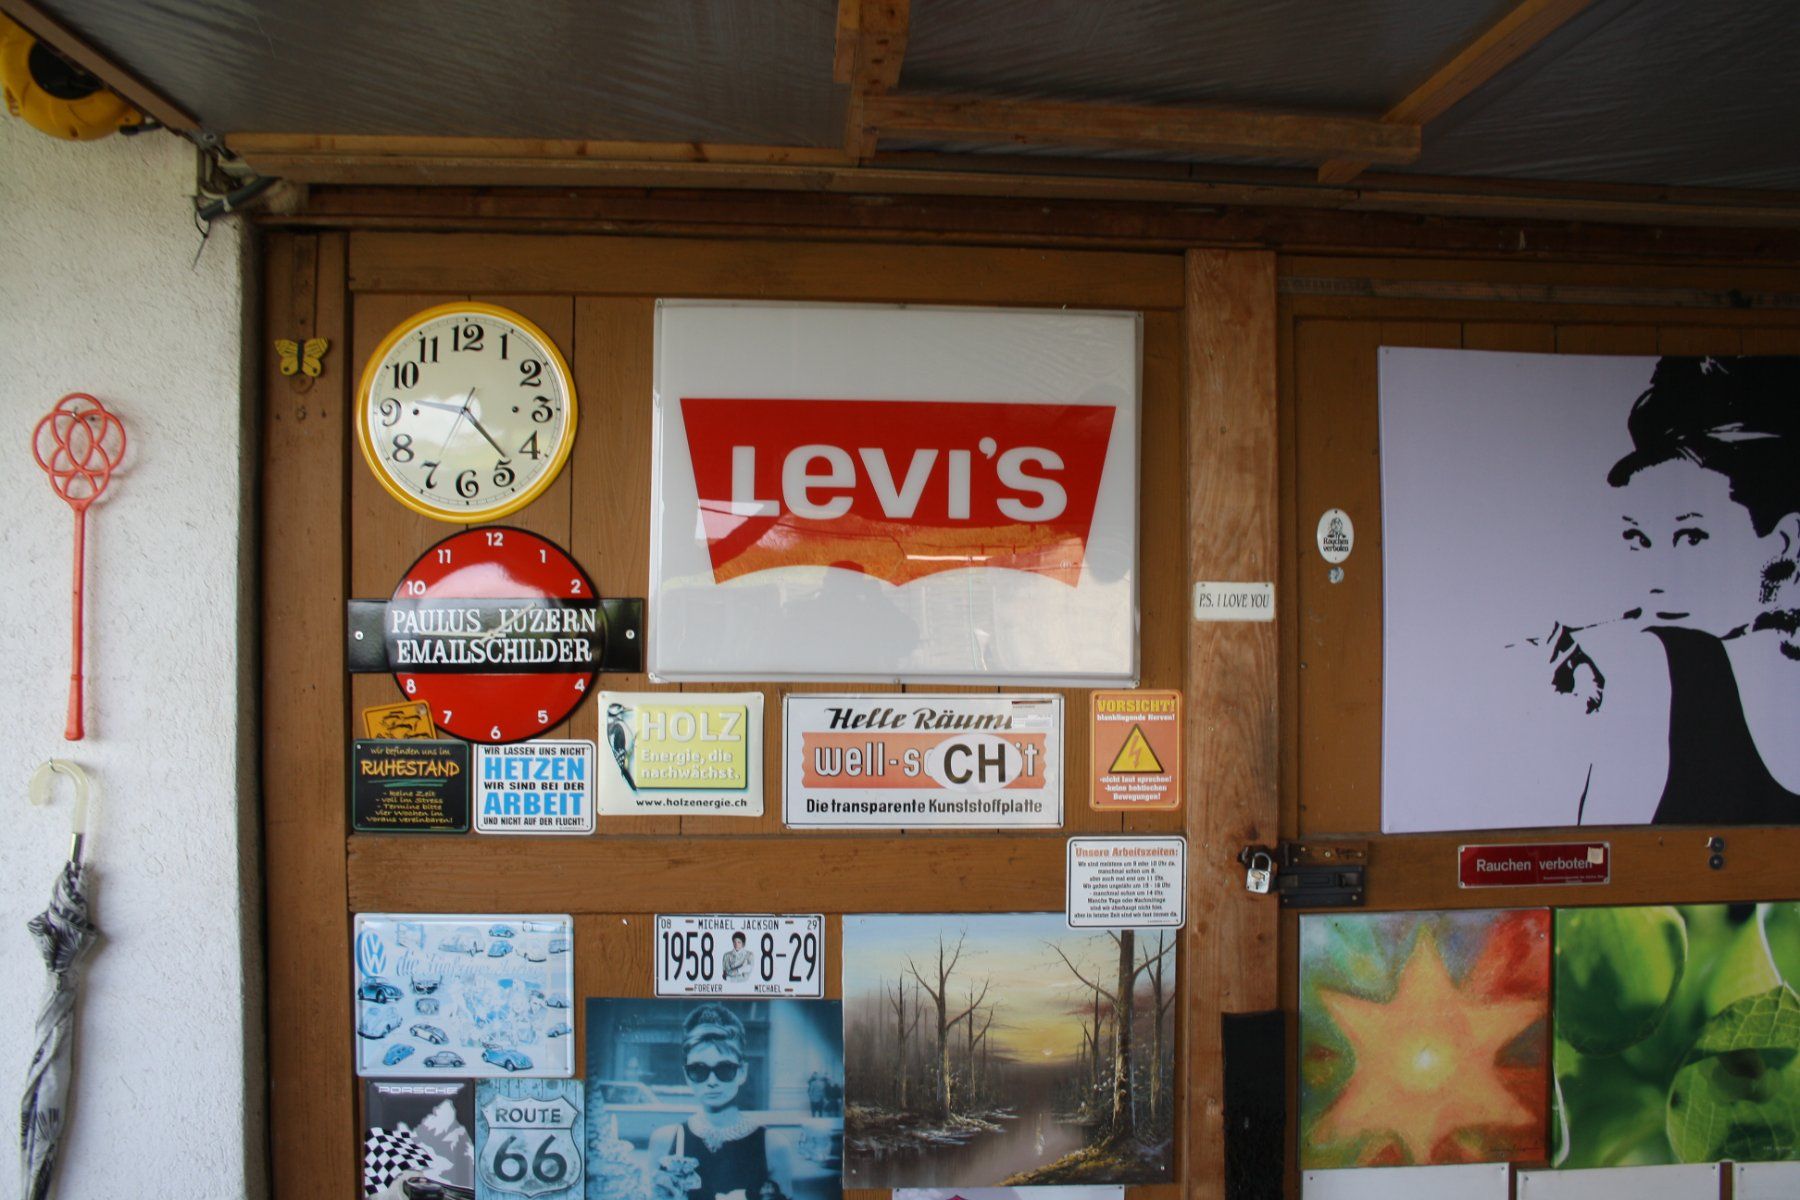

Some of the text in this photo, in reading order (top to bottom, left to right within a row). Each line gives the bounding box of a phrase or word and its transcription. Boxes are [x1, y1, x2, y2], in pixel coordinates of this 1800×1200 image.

[451, 324, 484, 352] 12
[419, 335, 440, 363] 11
[500, 333, 509, 360] 1
[391, 361, 419, 389] 10
[520, 359, 542, 387] 2
[380, 398, 401, 427] 9
[531, 396, 553, 423] 3
[392, 434, 415, 463] 8
[519, 430, 541, 460] 4
[420, 460, 441, 489] 7
[493, 459, 515, 487] 5
[455, 470, 479, 498] 6
[486, 532, 504, 547] 12
[437, 549, 451, 564] 11
[540, 549, 547, 563] 1
[407, 580, 426, 595] 10
[571, 579, 581, 594] 2
[1199, 593, 1270, 608] P.S. I LOVE YOU
[391, 608, 597, 634] PAULUS LUZERN
[397, 638, 592, 664] EMAILSCHILDER
[406, 679, 416, 693] 8
[574, 679, 585, 692] 4
[1097, 700, 1175, 712] VORSICHT!
[443, 711, 452, 724] 7
[538, 711, 548, 724] 5
[824, 708, 906, 730] Helle
[490, 726, 501, 740] 6
[641, 711, 742, 742] HOLZ
[386, 747, 420, 756] befinden
[422, 747, 437, 756] uns
[484, 747, 585, 755] WIR LASSEN UNS NICHT
[642, 749, 733, 765] Energie, die
[361, 759, 460, 777] RUHESTAND
[484, 757, 585, 780] HETZEN
[642, 764, 742, 779] nachwächst.
[943, 743, 1006, 784] CH
[484, 782, 585, 790] WIR SIND BEI DER
[483, 792, 584, 816] ARBEIT
[636, 798, 748, 809] www.holzenergie.ch
[807, 798, 1043, 815] Die transparente Kunststoffplatte
[483, 817, 584, 826] UND NICHT AUF DER FLUCHT!
[1076, 847, 1178, 857] Unsere Arbeitszeiten:
[1476, 857, 1593, 872] Rauchen verboten
[698, 919, 779, 930] MICHAEL JACKSON
[807, 920, 817, 930] 29
[662, 931, 714, 981] 1958
[760, 932, 817, 982] 8-29
[694, 984, 723, 992] FOREVER
[754, 984, 781, 992] MICHAEL
[379, 1086, 458, 1095] PORSCHE
[496, 1107, 561, 1123] ROUTE
[493, 1134, 567, 1183] 66
